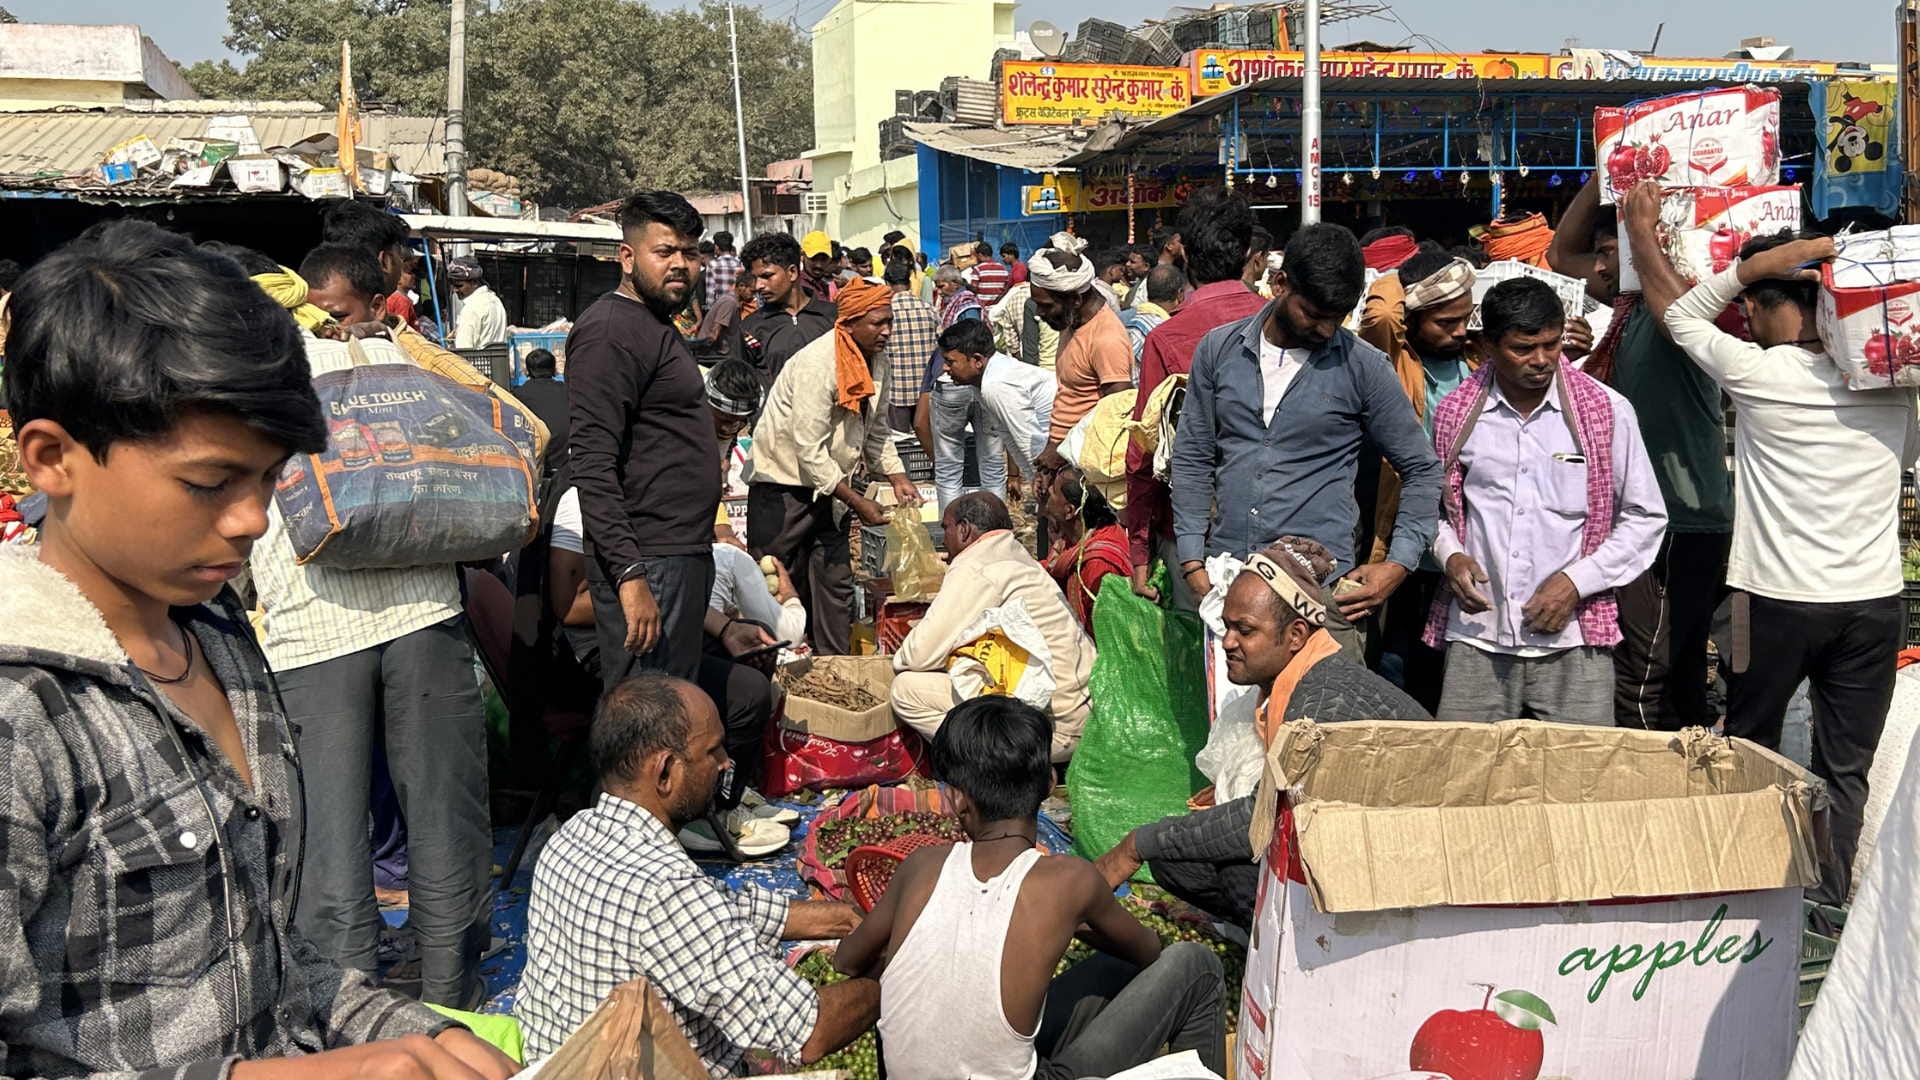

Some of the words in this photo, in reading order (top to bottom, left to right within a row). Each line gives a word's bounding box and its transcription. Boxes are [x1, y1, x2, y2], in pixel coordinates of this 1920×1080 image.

[1053, 77, 1089, 102] कुमार
[1127, 80, 1164, 104] कुमार
[1663, 108, 1740, 133] Anar
[370, 390, 427, 403] TOUCH
[368, 406, 393, 415] Mint
[1558, 903, 1774, 1003] apples
